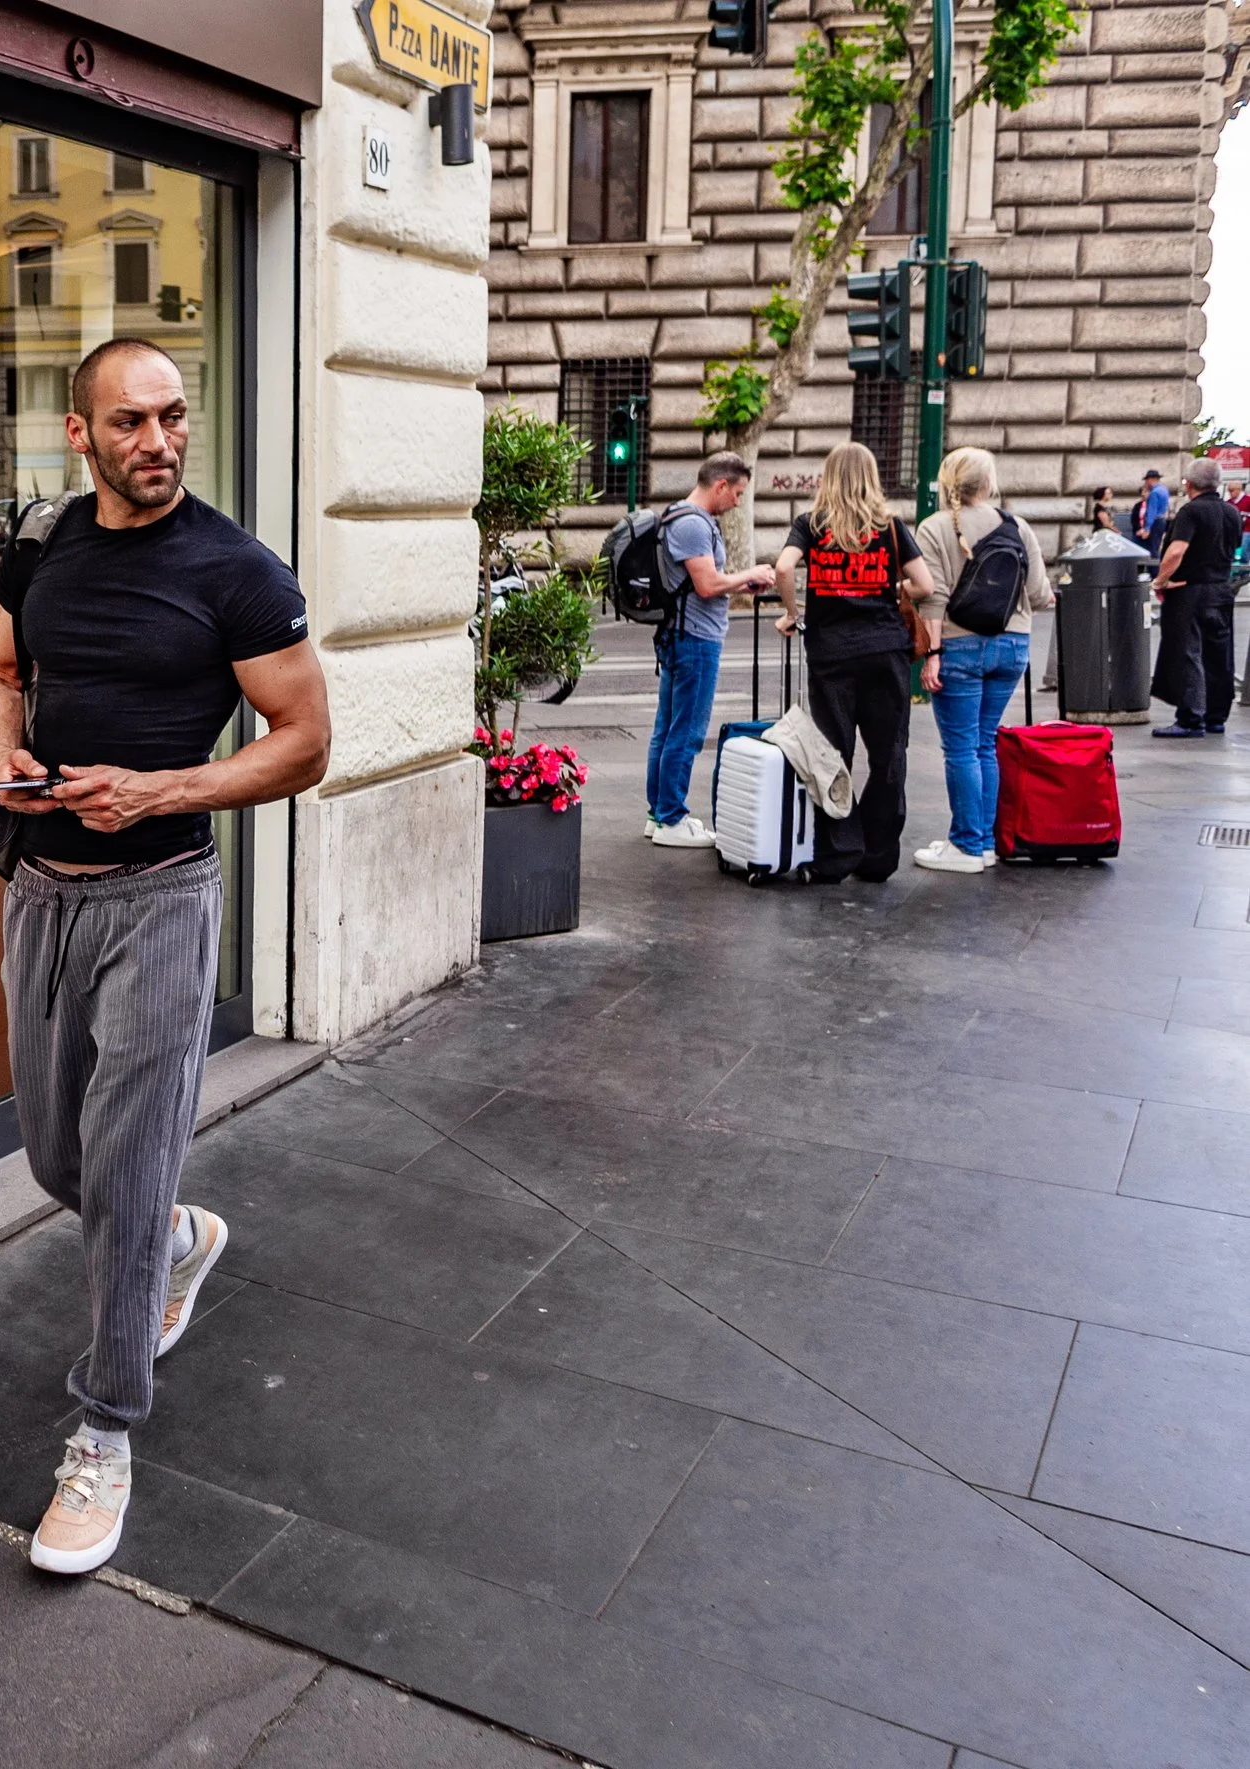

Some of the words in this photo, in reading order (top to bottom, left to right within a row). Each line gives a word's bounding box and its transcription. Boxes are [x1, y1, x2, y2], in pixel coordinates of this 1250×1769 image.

[430, 24, 480, 88] DANTE
[369, 138, 390, 176] 80
[810, 548, 845, 565] New
[810, 564, 843, 582] Run
[845, 564, 888, 582] Club
